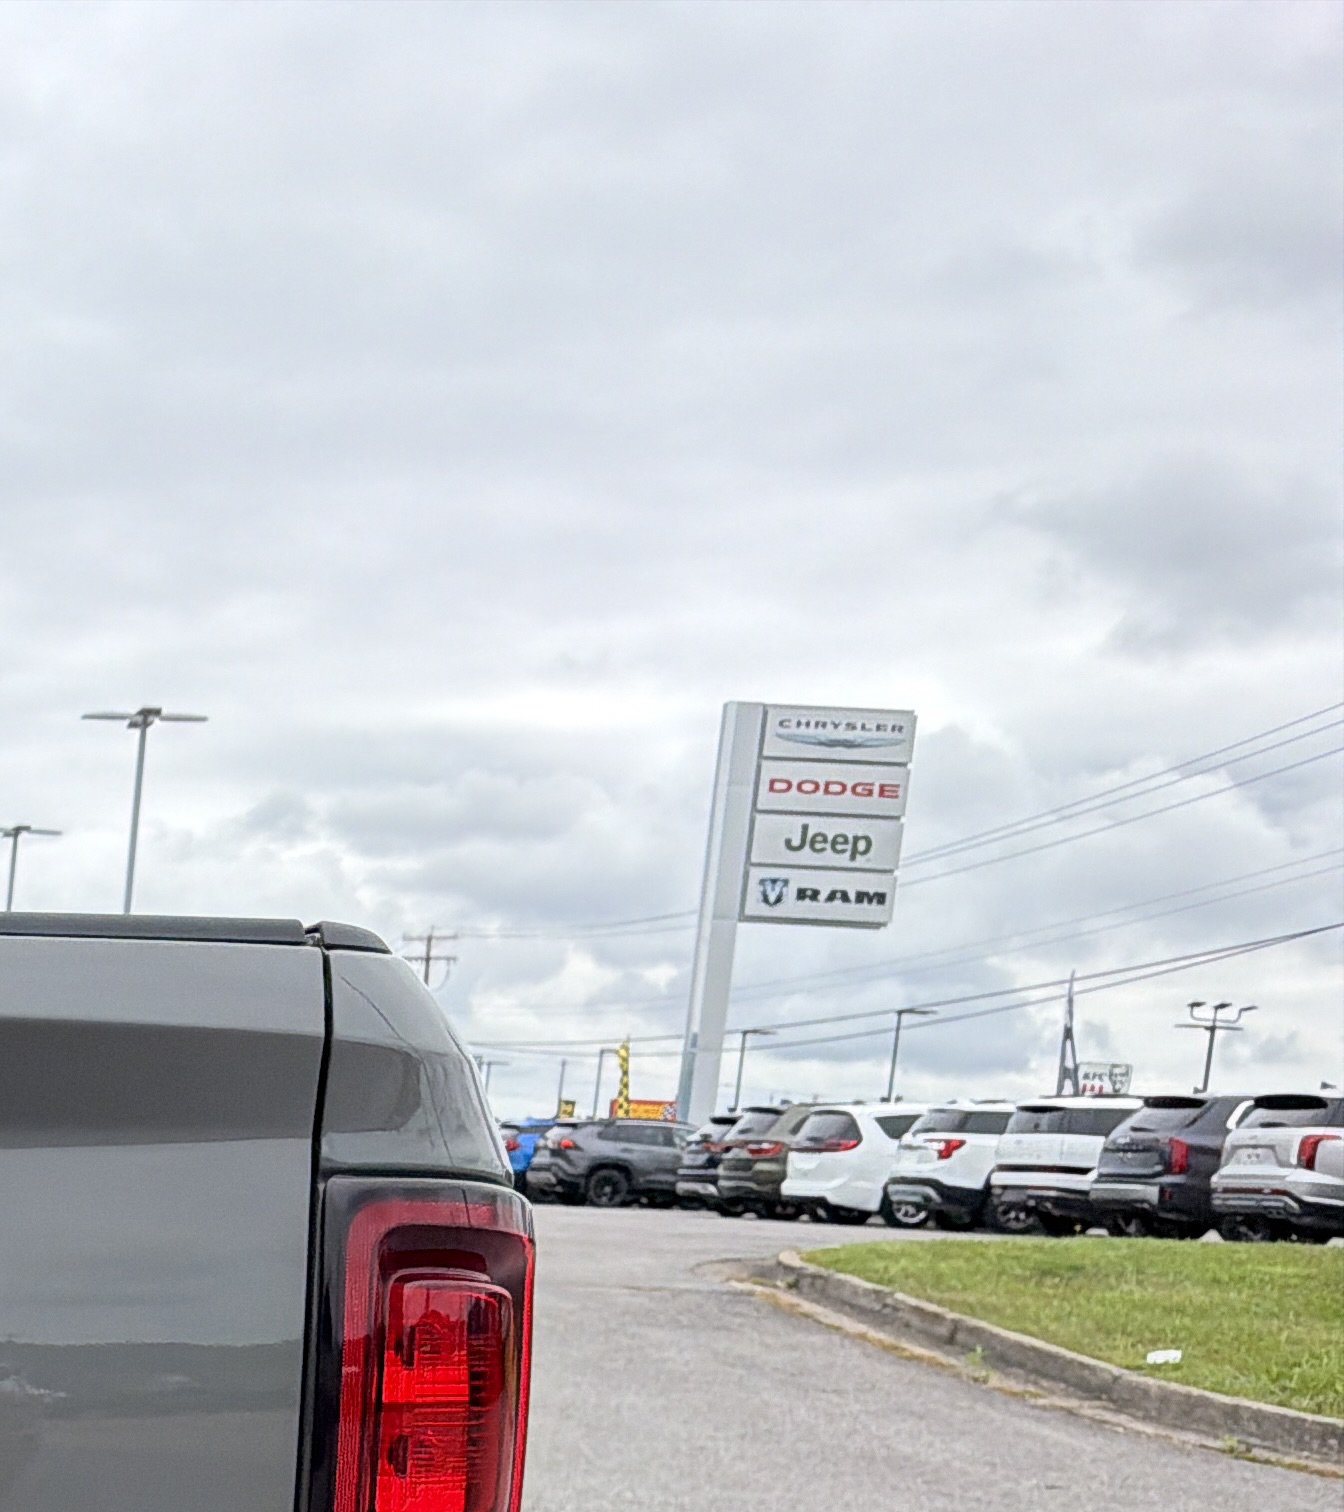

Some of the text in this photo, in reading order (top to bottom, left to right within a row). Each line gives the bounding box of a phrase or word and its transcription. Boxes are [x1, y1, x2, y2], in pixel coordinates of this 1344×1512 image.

[778, 719, 905, 733] CHRYSLER
[768, 778, 901, 799] DODGE
[785, 823, 873, 862] Jeep
[796, 887, 887, 906] RAM
